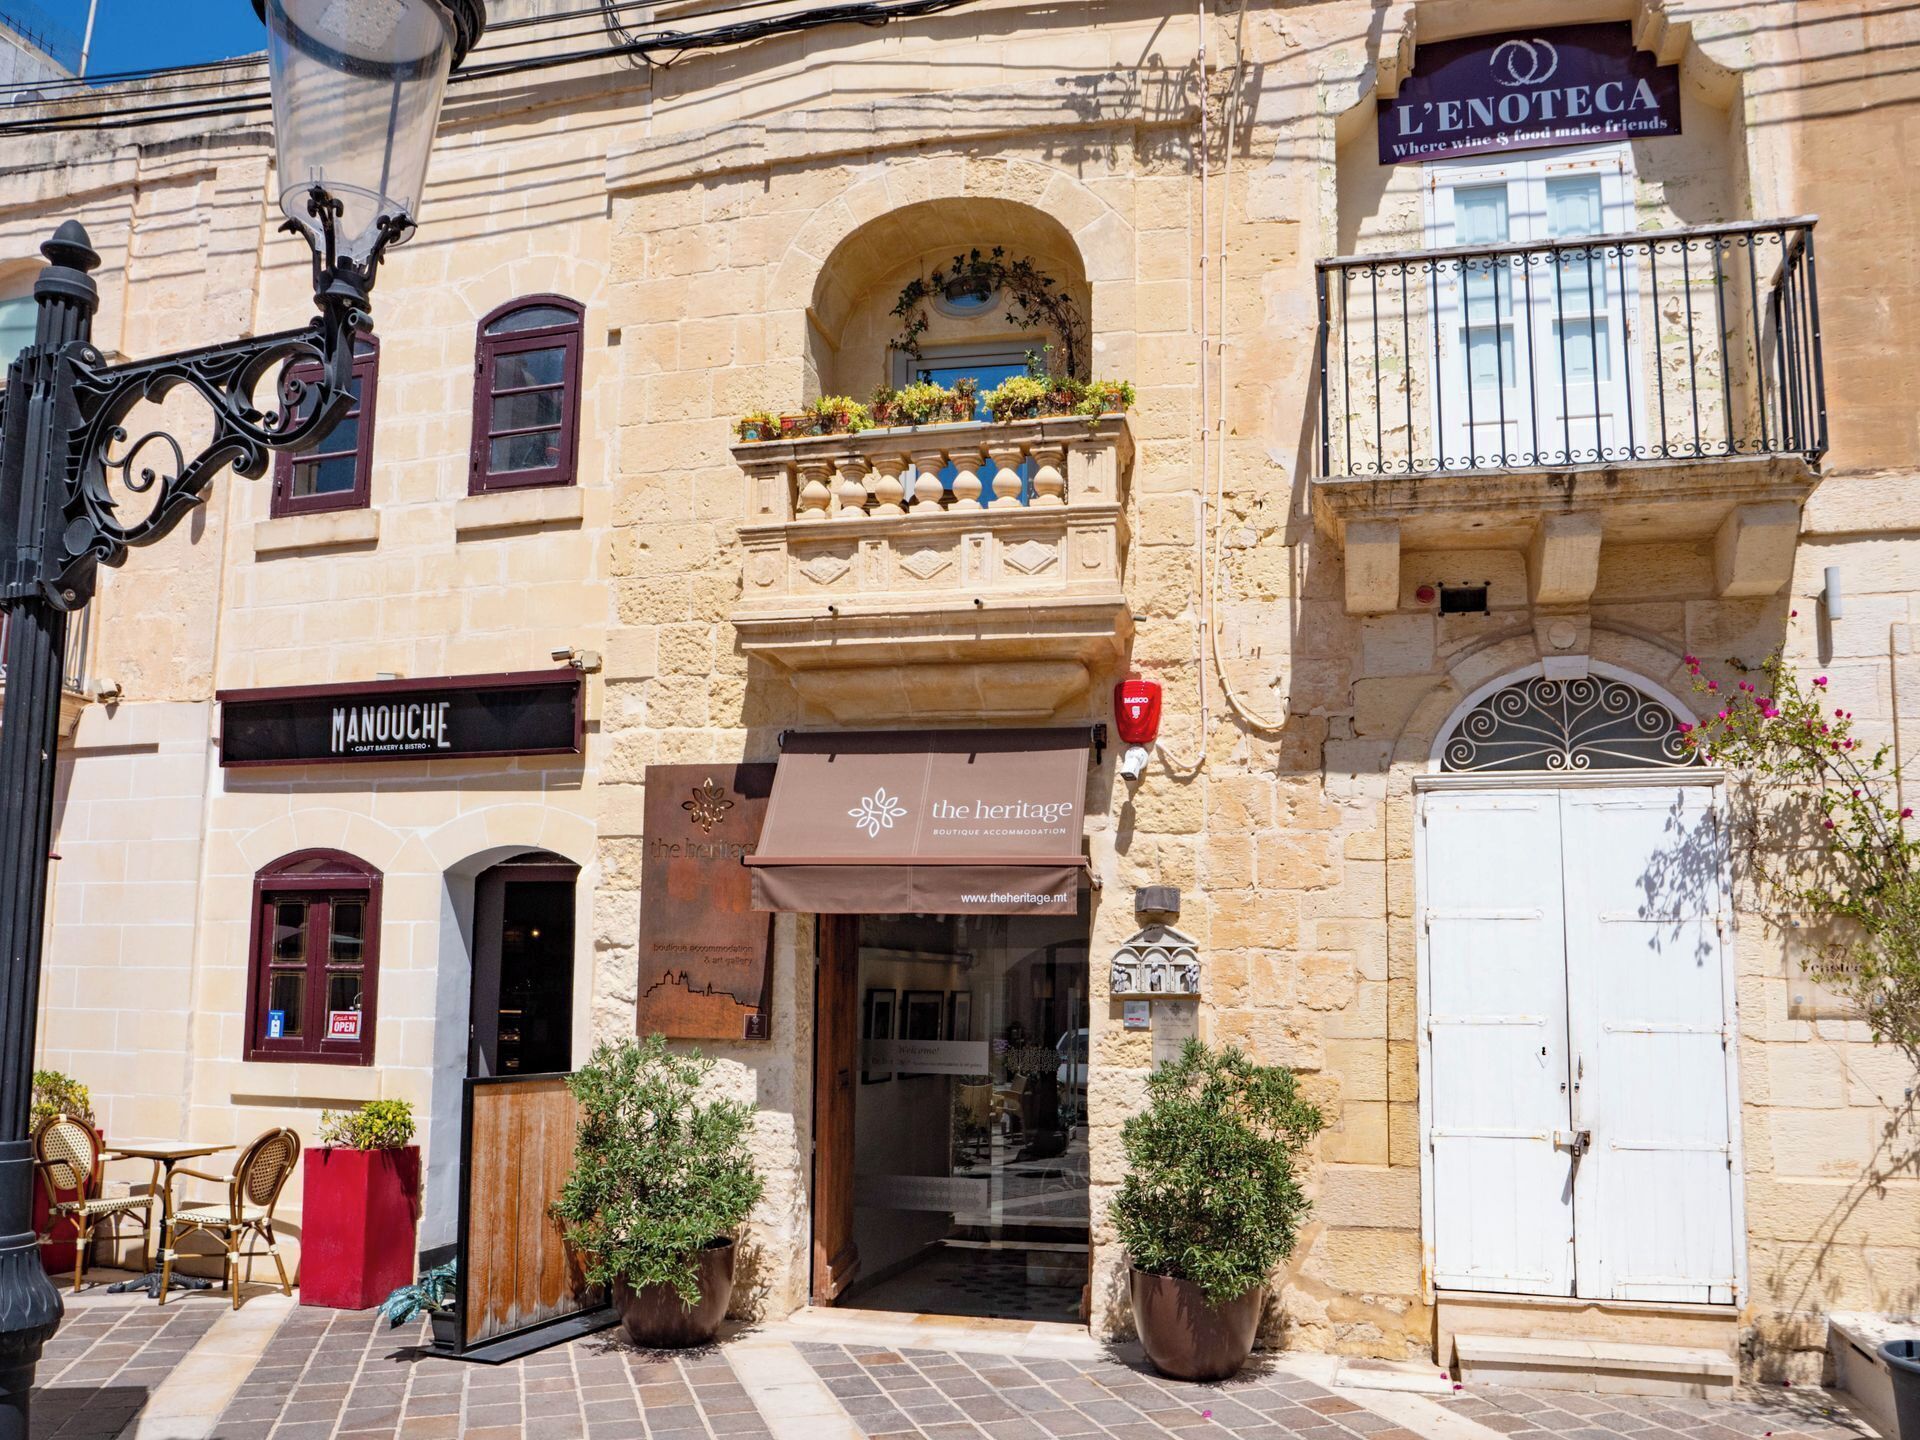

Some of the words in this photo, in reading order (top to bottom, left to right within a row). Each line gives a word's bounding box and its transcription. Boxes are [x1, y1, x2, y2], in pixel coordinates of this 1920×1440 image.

[1397, 78, 1660, 136] L'ENOTECA
[1392, 141, 1447, 157] Where
[1452, 136, 1491, 149] wine
[1496, 131, 1509, 146] &
[1514, 127, 1551, 141] food
[1555, 122, 1600, 137] make
[1605, 115, 1668, 133] friends
[331, 702, 451, 753] MANOUCHE
[932, 800, 969, 819] the
[974, 799, 1073, 823] heritage
[983, 828, 1066, 836] ACCOMMODATION
[650, 837, 681, 859] the
[961, 892, 1067, 905] www.theheritage.mt
[653, 943, 687, 953] boutique
[690, 944, 753, 953] accommodation
[334, 1021, 355, 1032] OPEN
